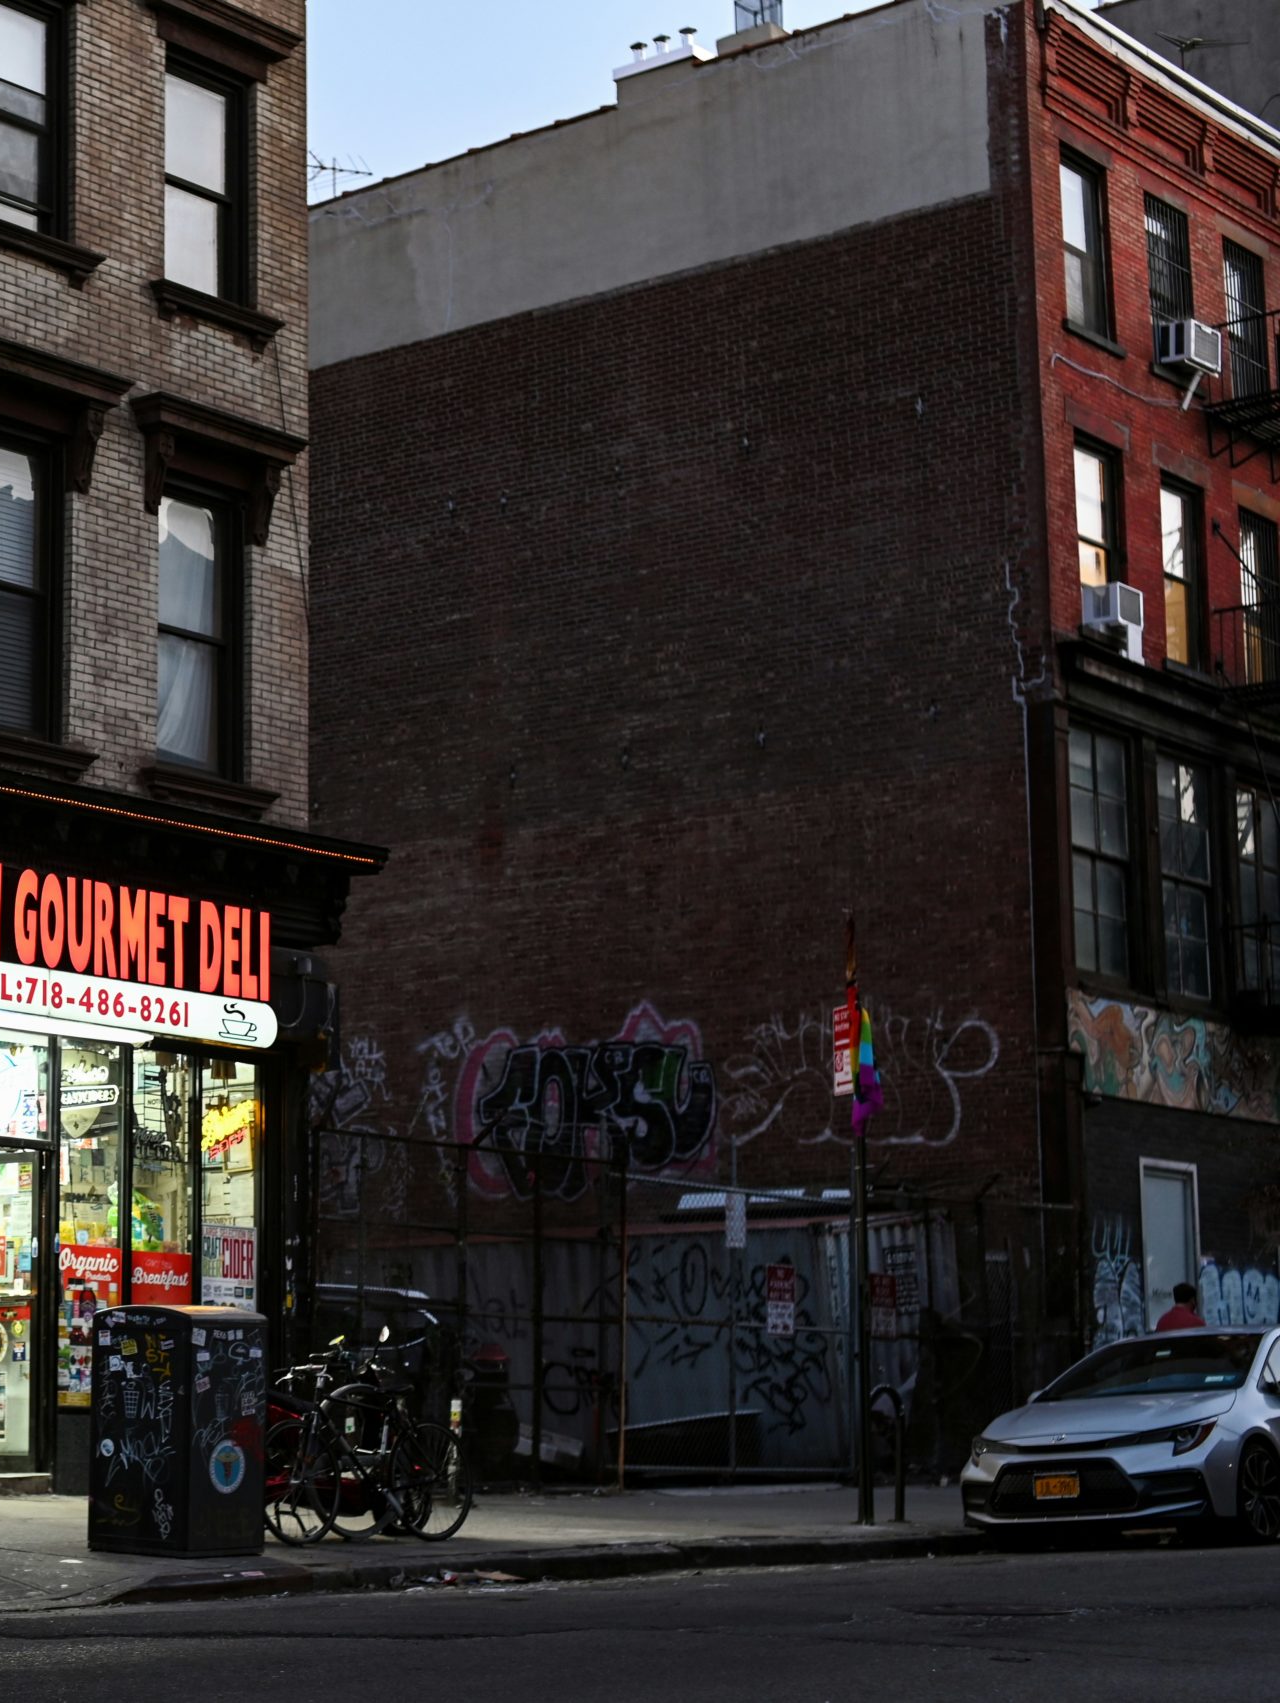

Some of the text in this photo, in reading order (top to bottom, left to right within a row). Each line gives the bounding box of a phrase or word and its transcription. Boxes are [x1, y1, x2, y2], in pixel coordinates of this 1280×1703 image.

[14, 869, 190, 988] GOURMET
[199, 900, 271, 1002] DELI
[59, 1247, 119, 1277] Organic
[222, 1237, 254, 1280] CIDER
[131, 1267, 189, 1291] Breakfast
